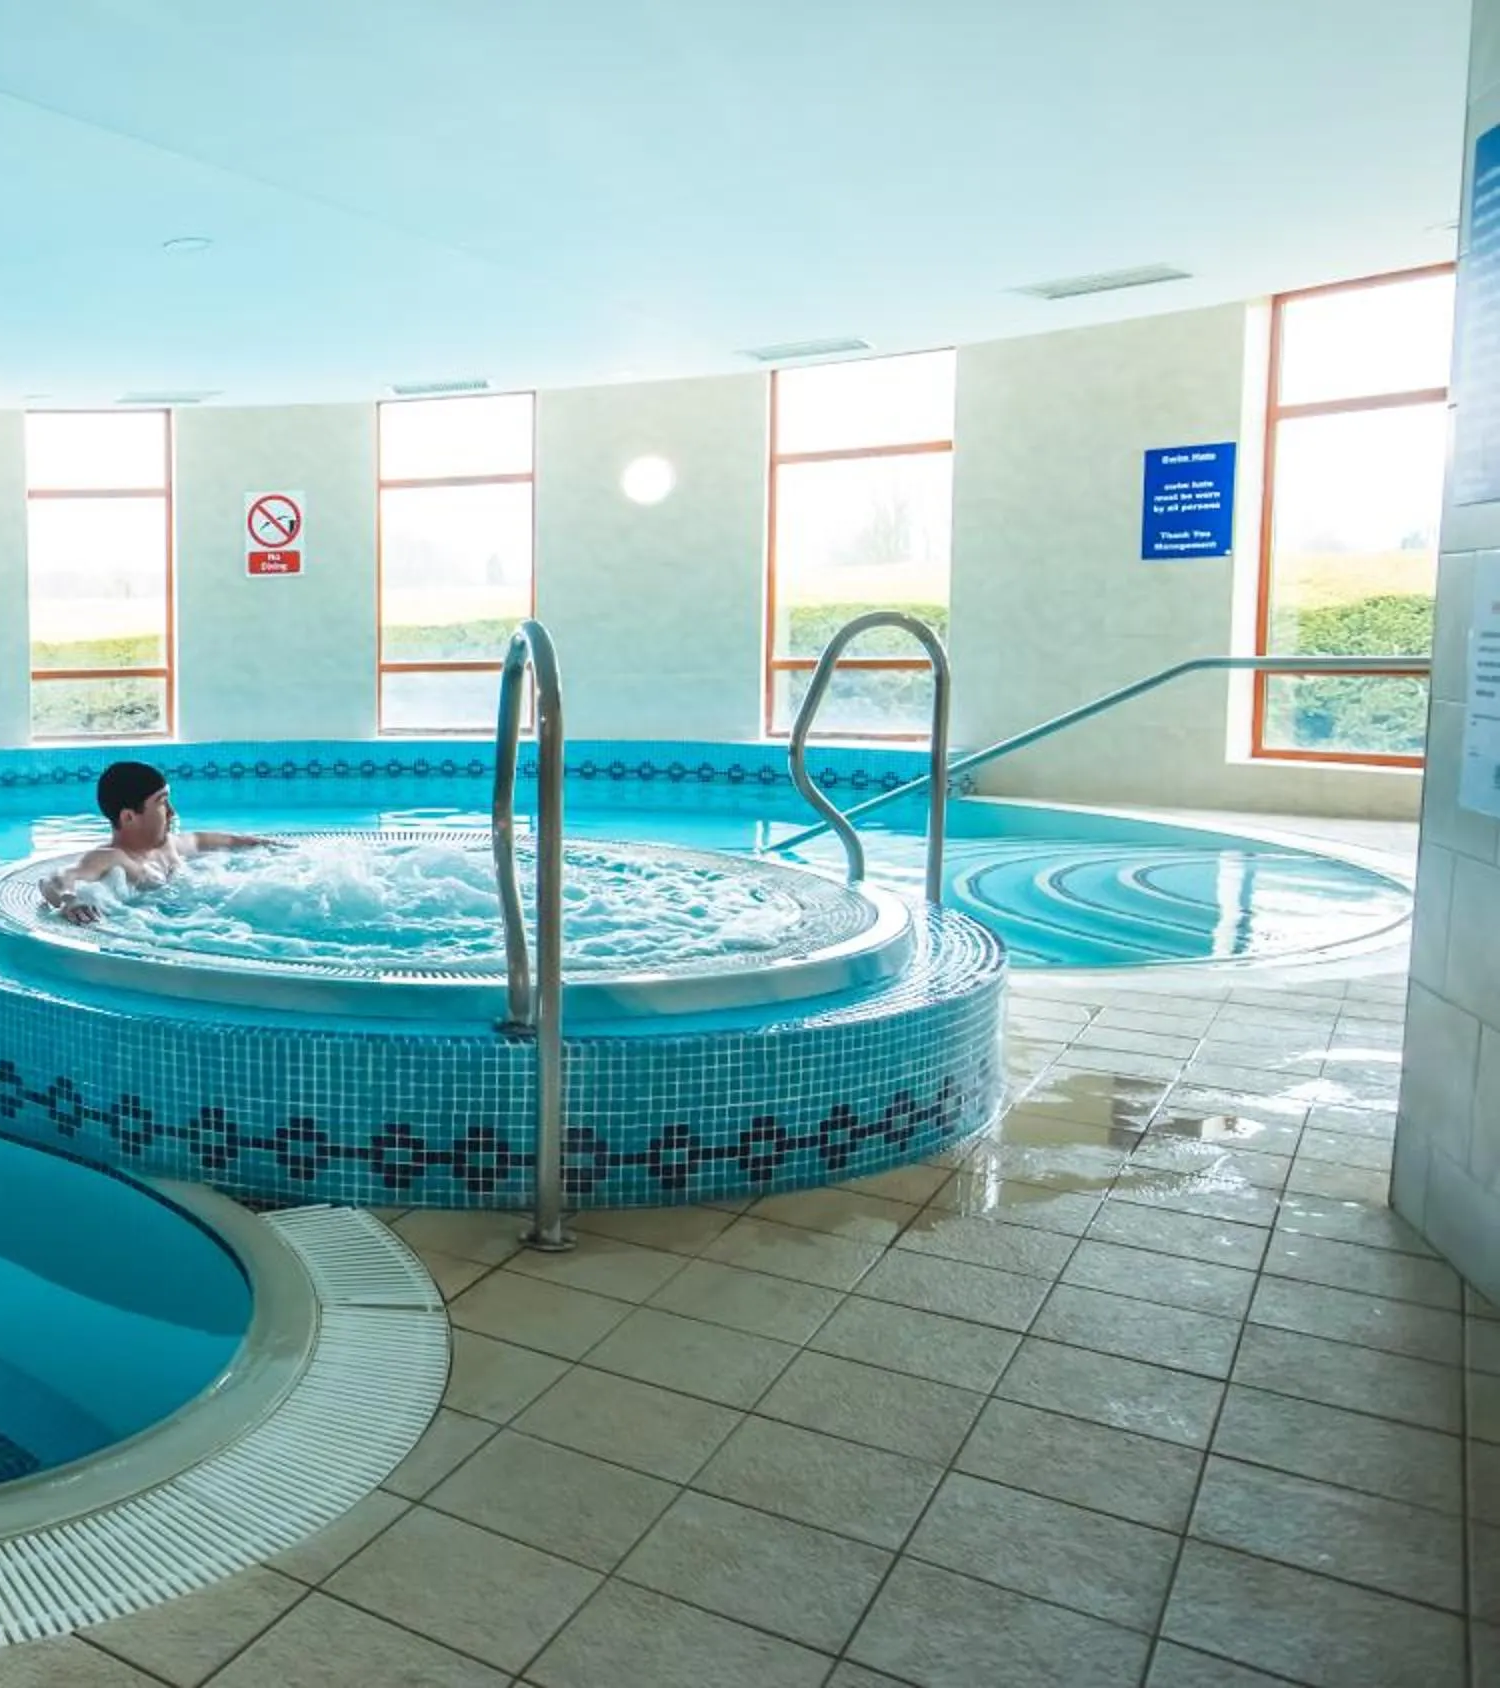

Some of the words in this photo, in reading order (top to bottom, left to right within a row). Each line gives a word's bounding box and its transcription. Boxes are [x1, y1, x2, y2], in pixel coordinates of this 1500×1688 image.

[1180, 493, 1192, 501] be
[1153, 505, 1164, 514] by
[1160, 531, 1189, 540] Thank
